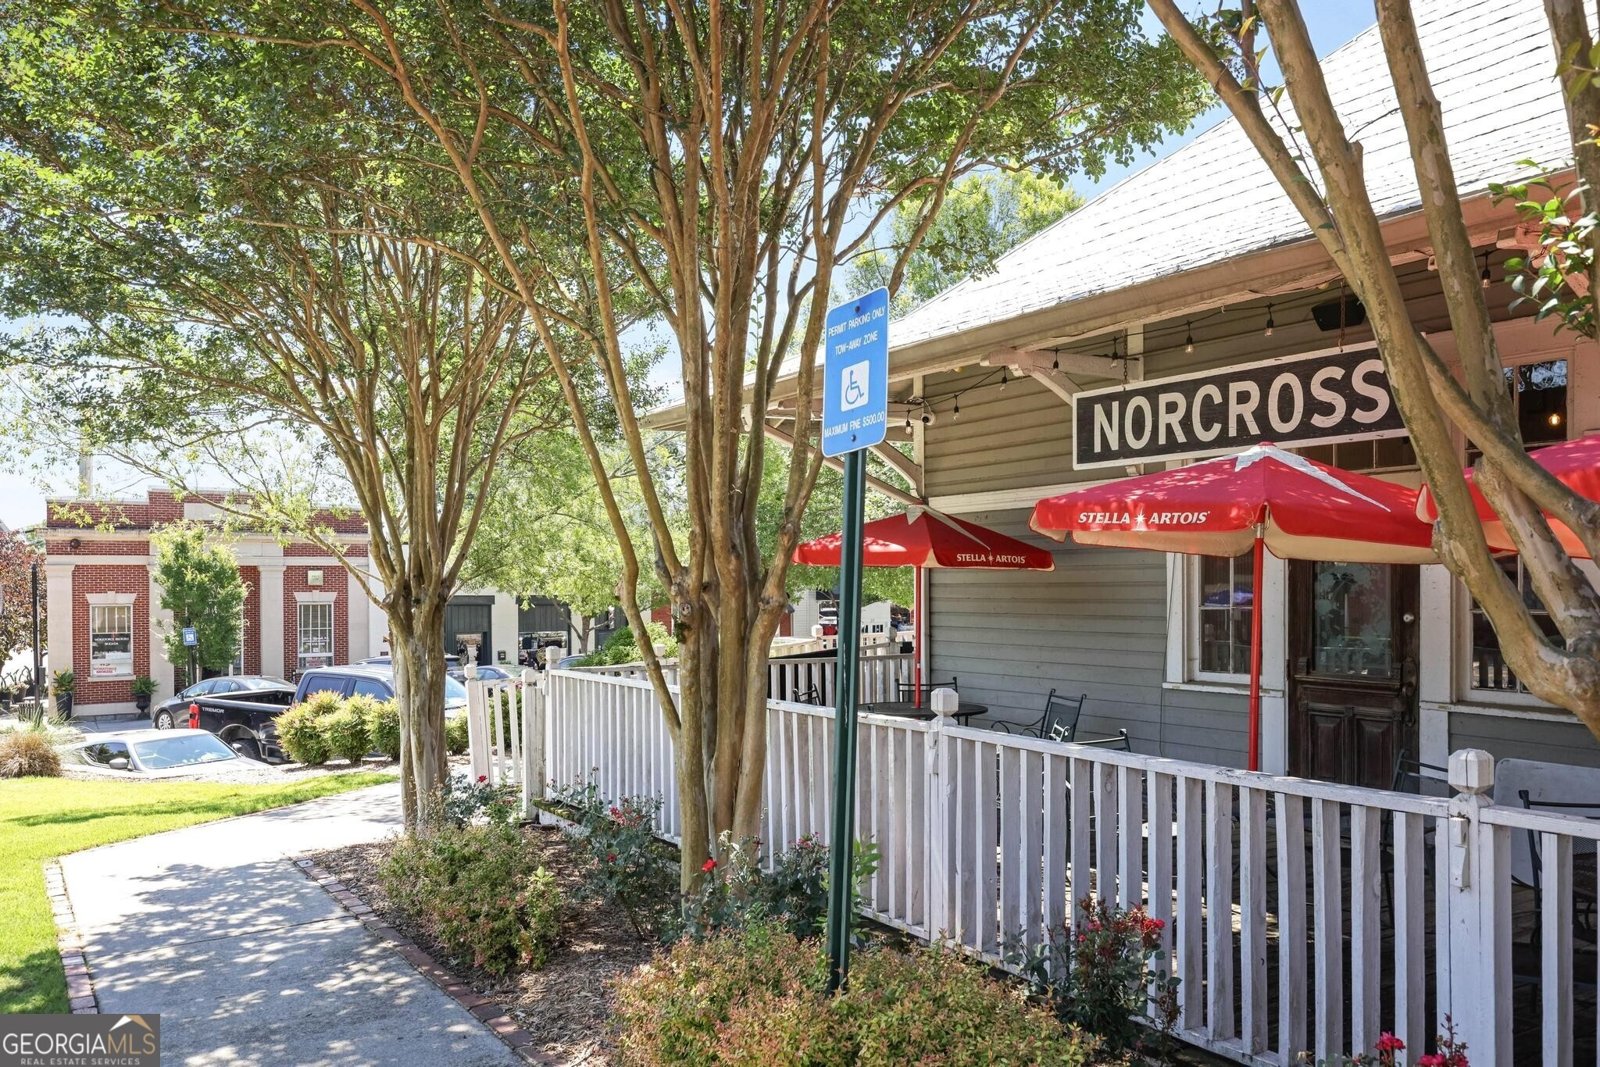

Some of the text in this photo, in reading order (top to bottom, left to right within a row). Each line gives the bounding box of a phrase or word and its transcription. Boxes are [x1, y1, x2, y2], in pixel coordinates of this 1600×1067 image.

[828, 306, 886, 337] PERMIT PARKING ONLY
[835, 331, 878, 356] TOW-AWAY ZONE
[1093, 358, 1390, 453] NORCROSS
[824, 411, 884, 438] MAXIMUM FINE $500.00
[1078, 512, 1208, 524] STELLA ARTOIS
[956, 554, 1026, 564] STELLA ARTOIS
